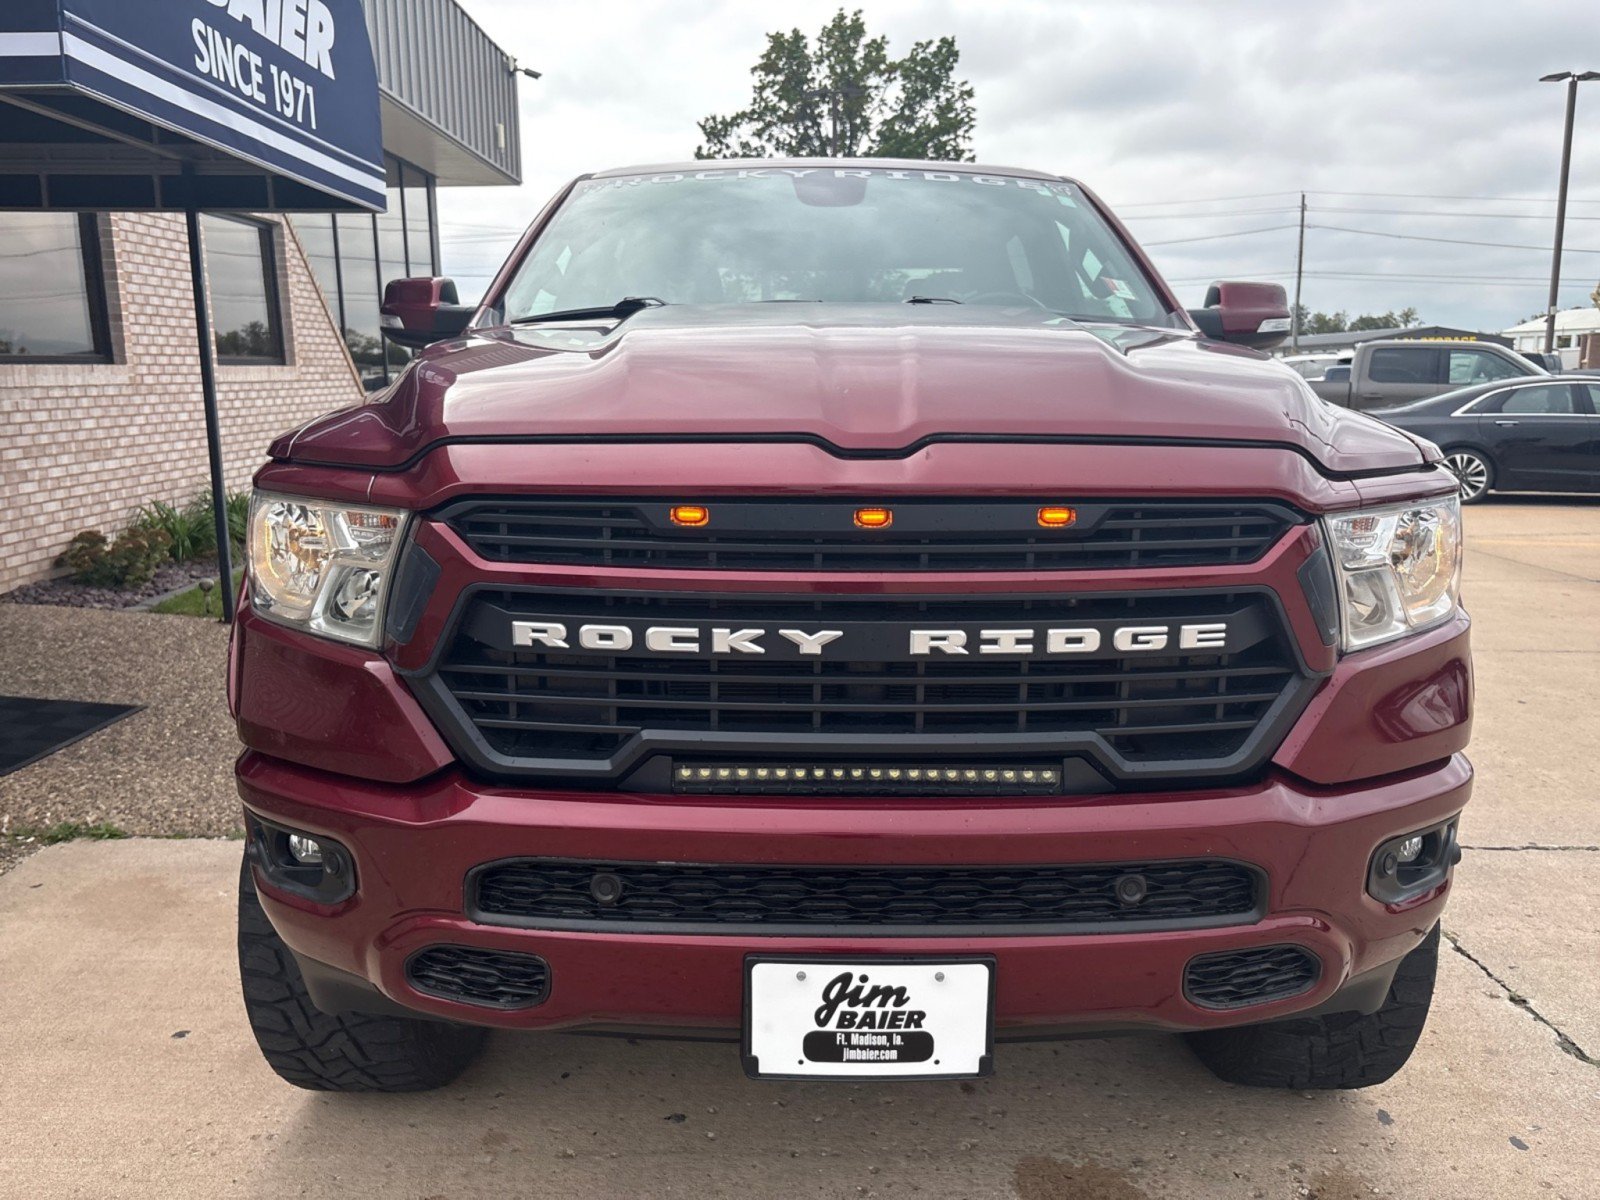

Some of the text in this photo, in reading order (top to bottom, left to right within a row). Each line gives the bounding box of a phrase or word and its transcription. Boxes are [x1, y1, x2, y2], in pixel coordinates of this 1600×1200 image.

[207, 0, 336, 81] IER
[191, 17, 317, 130] SINCE 1971
[833, 169, 1043, 190] RIDGE
[511, 620, 1227, 657] ROCKY RIDGE
[814, 971, 911, 1028] Jim
[835, 1010, 927, 1030] BAIER
[836, 1032, 848, 1046] Ft.
[850, 1032, 890, 1048] Madison,
[842, 1047, 898, 1062] jimbaier.com
